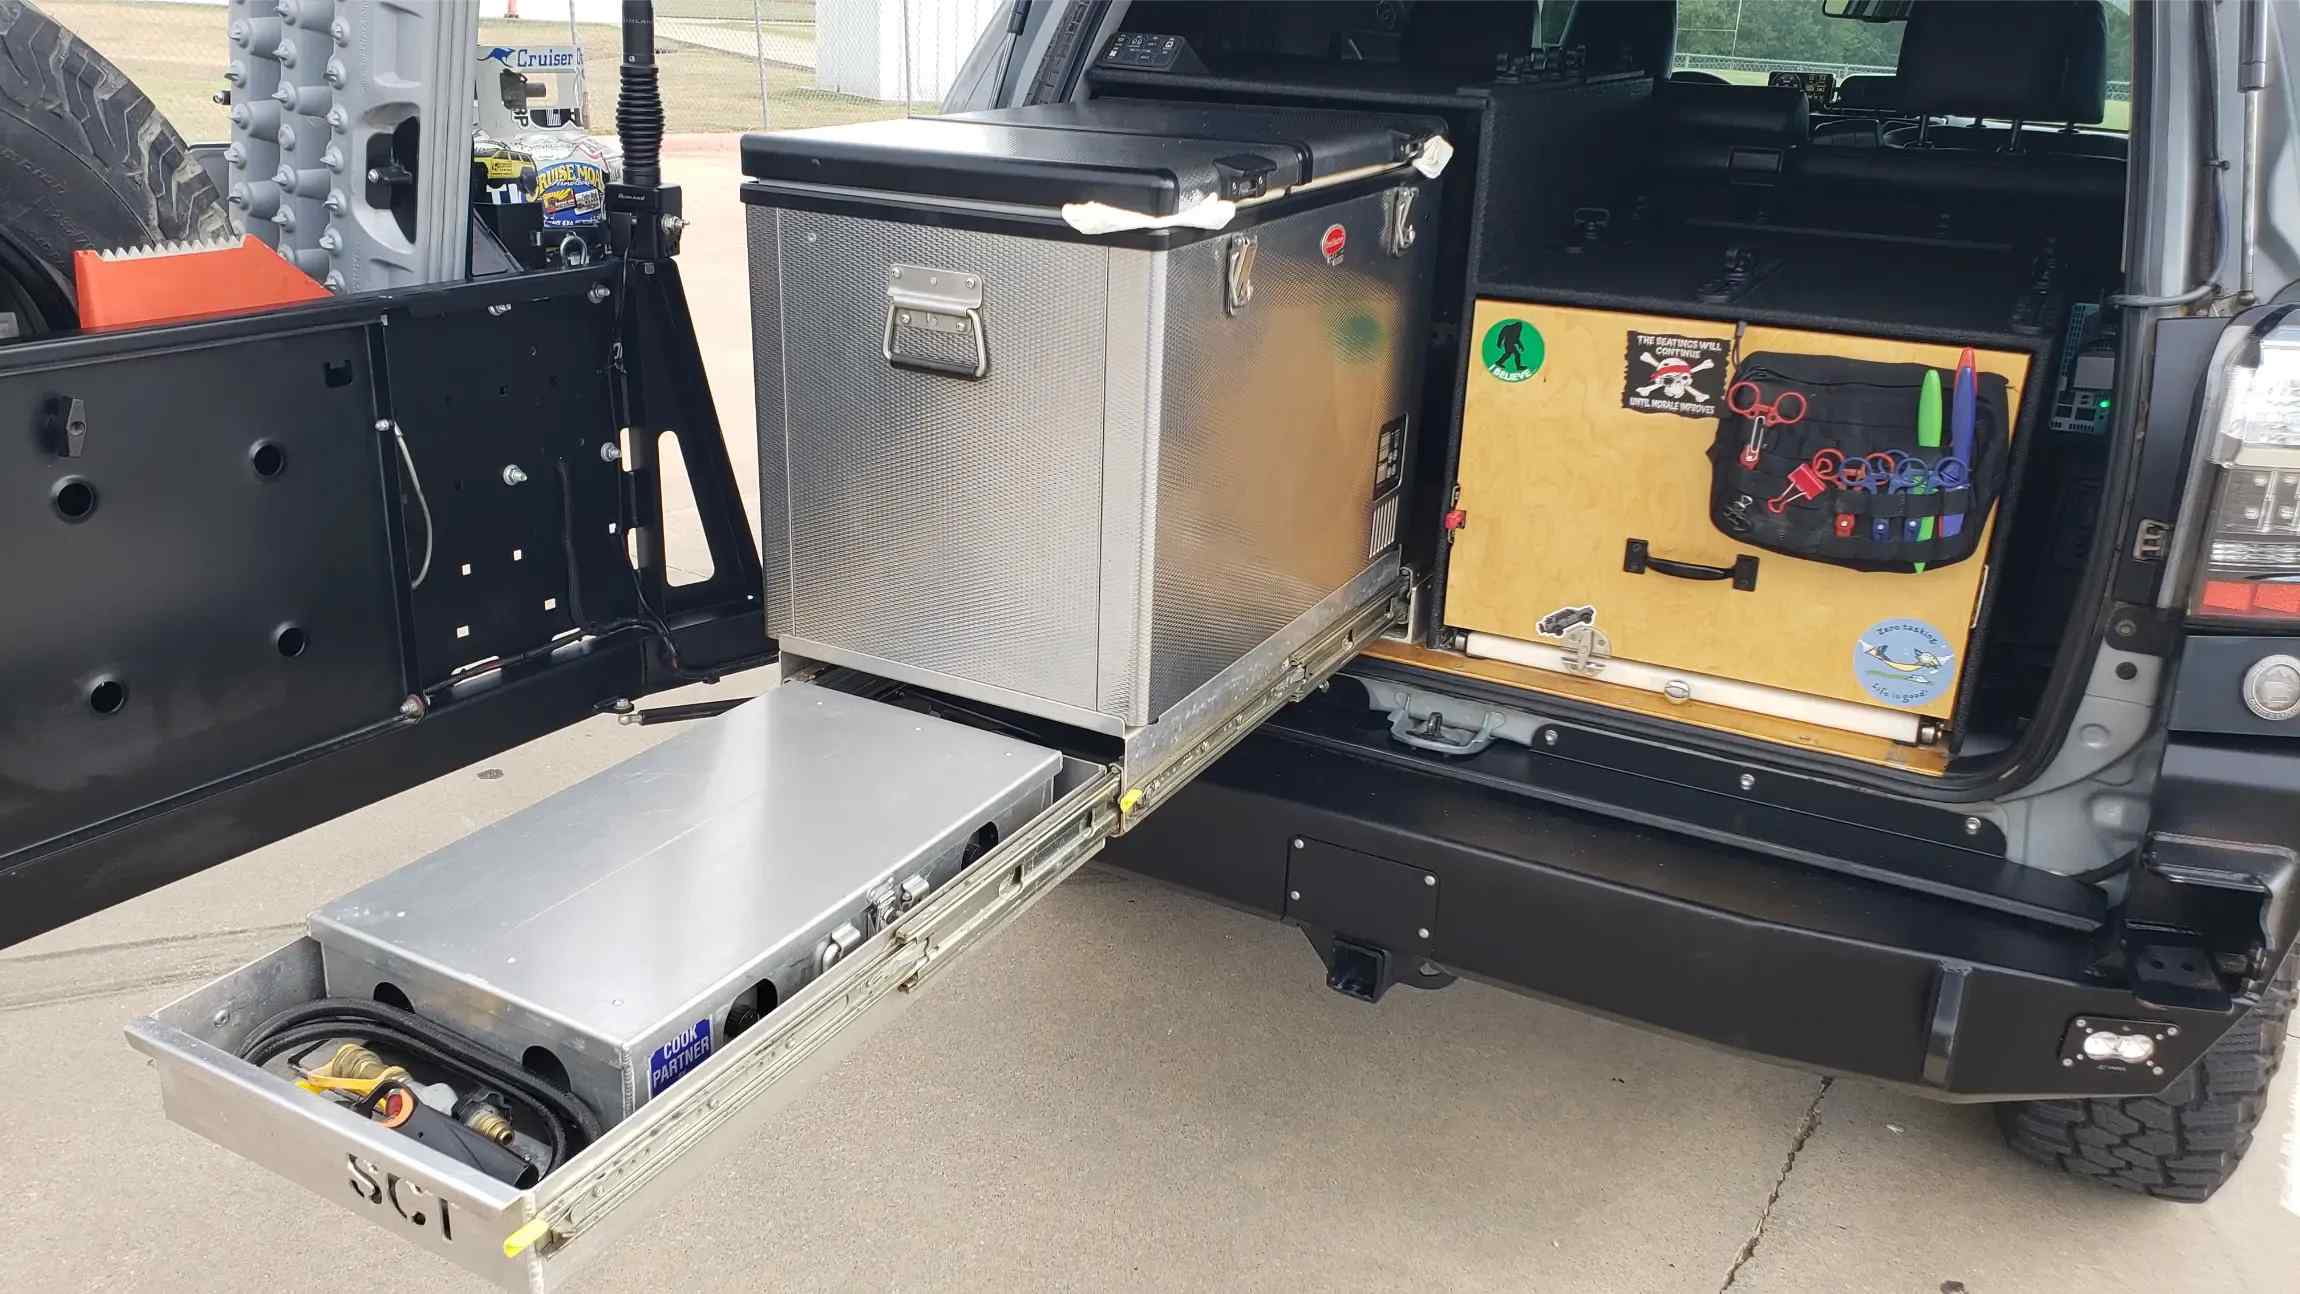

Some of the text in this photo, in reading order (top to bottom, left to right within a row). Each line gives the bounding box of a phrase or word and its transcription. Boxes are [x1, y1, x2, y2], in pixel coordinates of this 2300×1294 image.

[517, 48, 573, 67] Cruiser
[1637, 335, 1722, 351] THE BEATINGS WILL
[1655, 346, 1701, 358] CONTINUE
[1629, 396, 1716, 414] UNTIL MORALE IMPROVES
[1872, 682, 1889, 697] Life
[652, 1023, 710, 1089] COOK PARTNER
